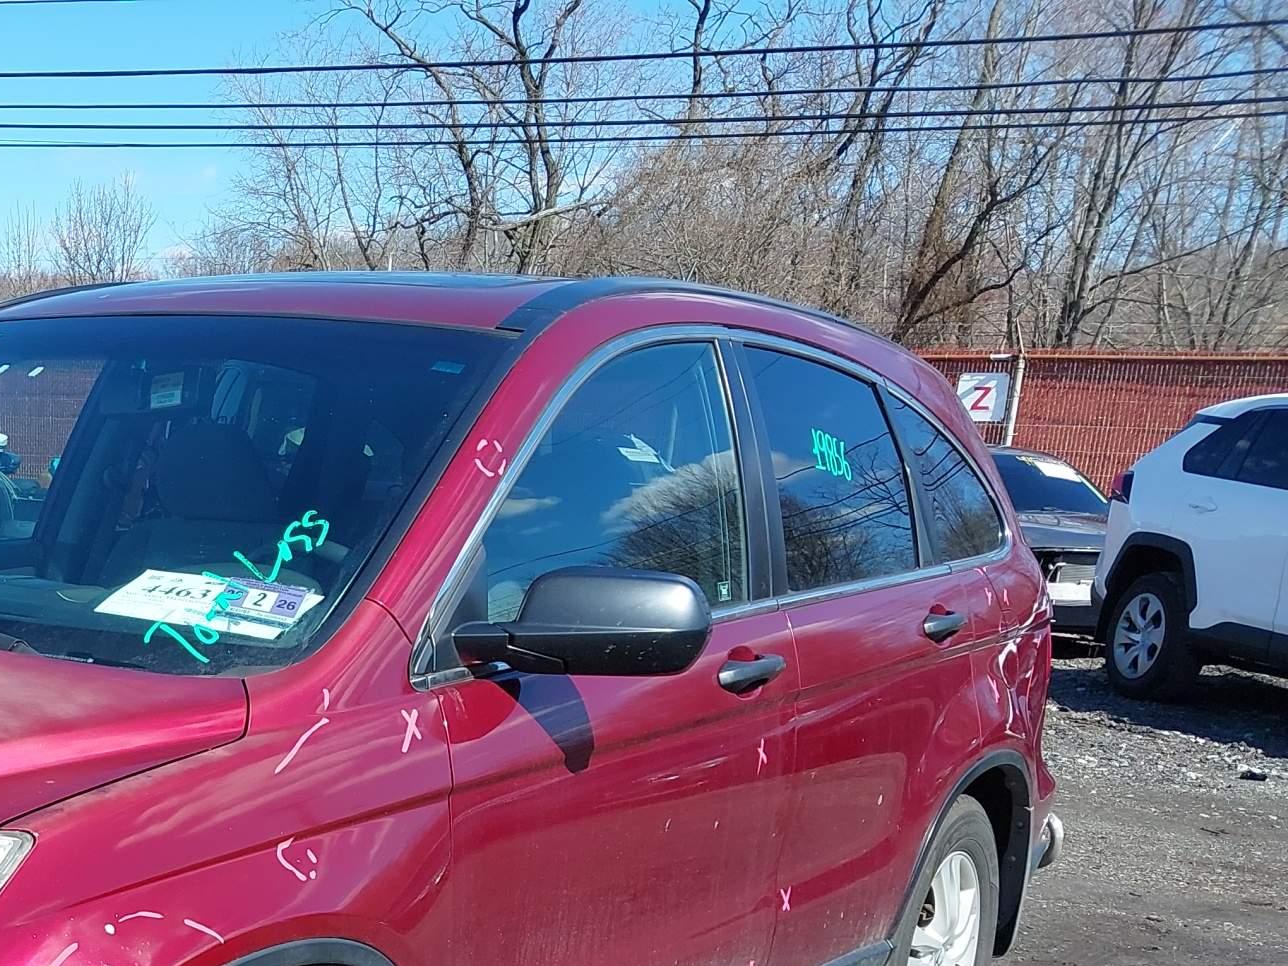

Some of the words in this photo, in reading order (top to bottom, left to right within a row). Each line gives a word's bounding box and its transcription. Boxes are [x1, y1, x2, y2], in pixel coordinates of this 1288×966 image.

[970, 386, 992, 410] Z
[252, 592, 268, 607] 2
[275, 599, 297, 611] 26
